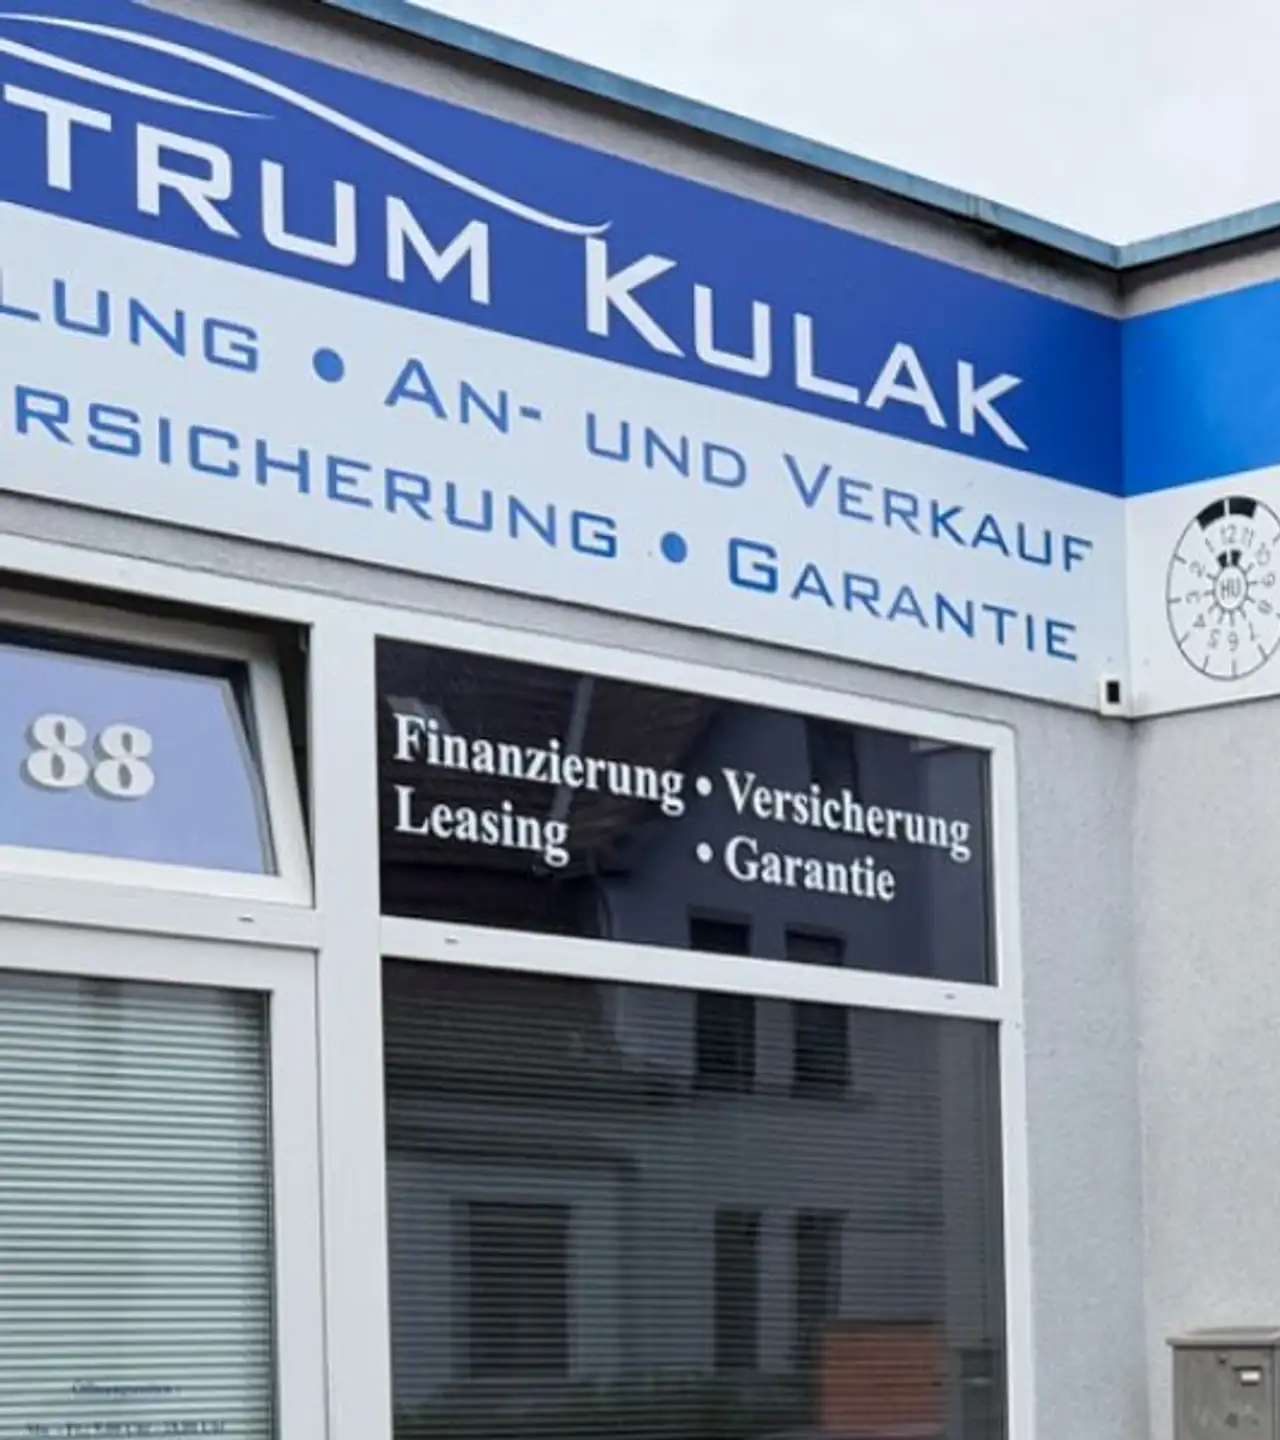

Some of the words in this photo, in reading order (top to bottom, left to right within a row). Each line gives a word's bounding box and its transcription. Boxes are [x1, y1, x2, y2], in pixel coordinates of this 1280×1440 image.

[5, 85, 488, 303] TRUM
[584, 237, 1028, 451] KULAK
[15, 385, 617, 558] RSICHERUNG
[728, 538, 1076, 661] GARANTIE
[385, 359, 541, 433] AN-
[586, 413, 746, 488] UND
[784, 454, 1093, 572] VERKAUF
[1220, 576, 1243, 601] HU
[29, 717, 153, 795] 88
[394, 713, 684, 815] Finanzierung
[724, 769, 971, 862] Versicherung
[396, 786, 568, 866] Leasing
[726, 836, 894, 900] Garantie
